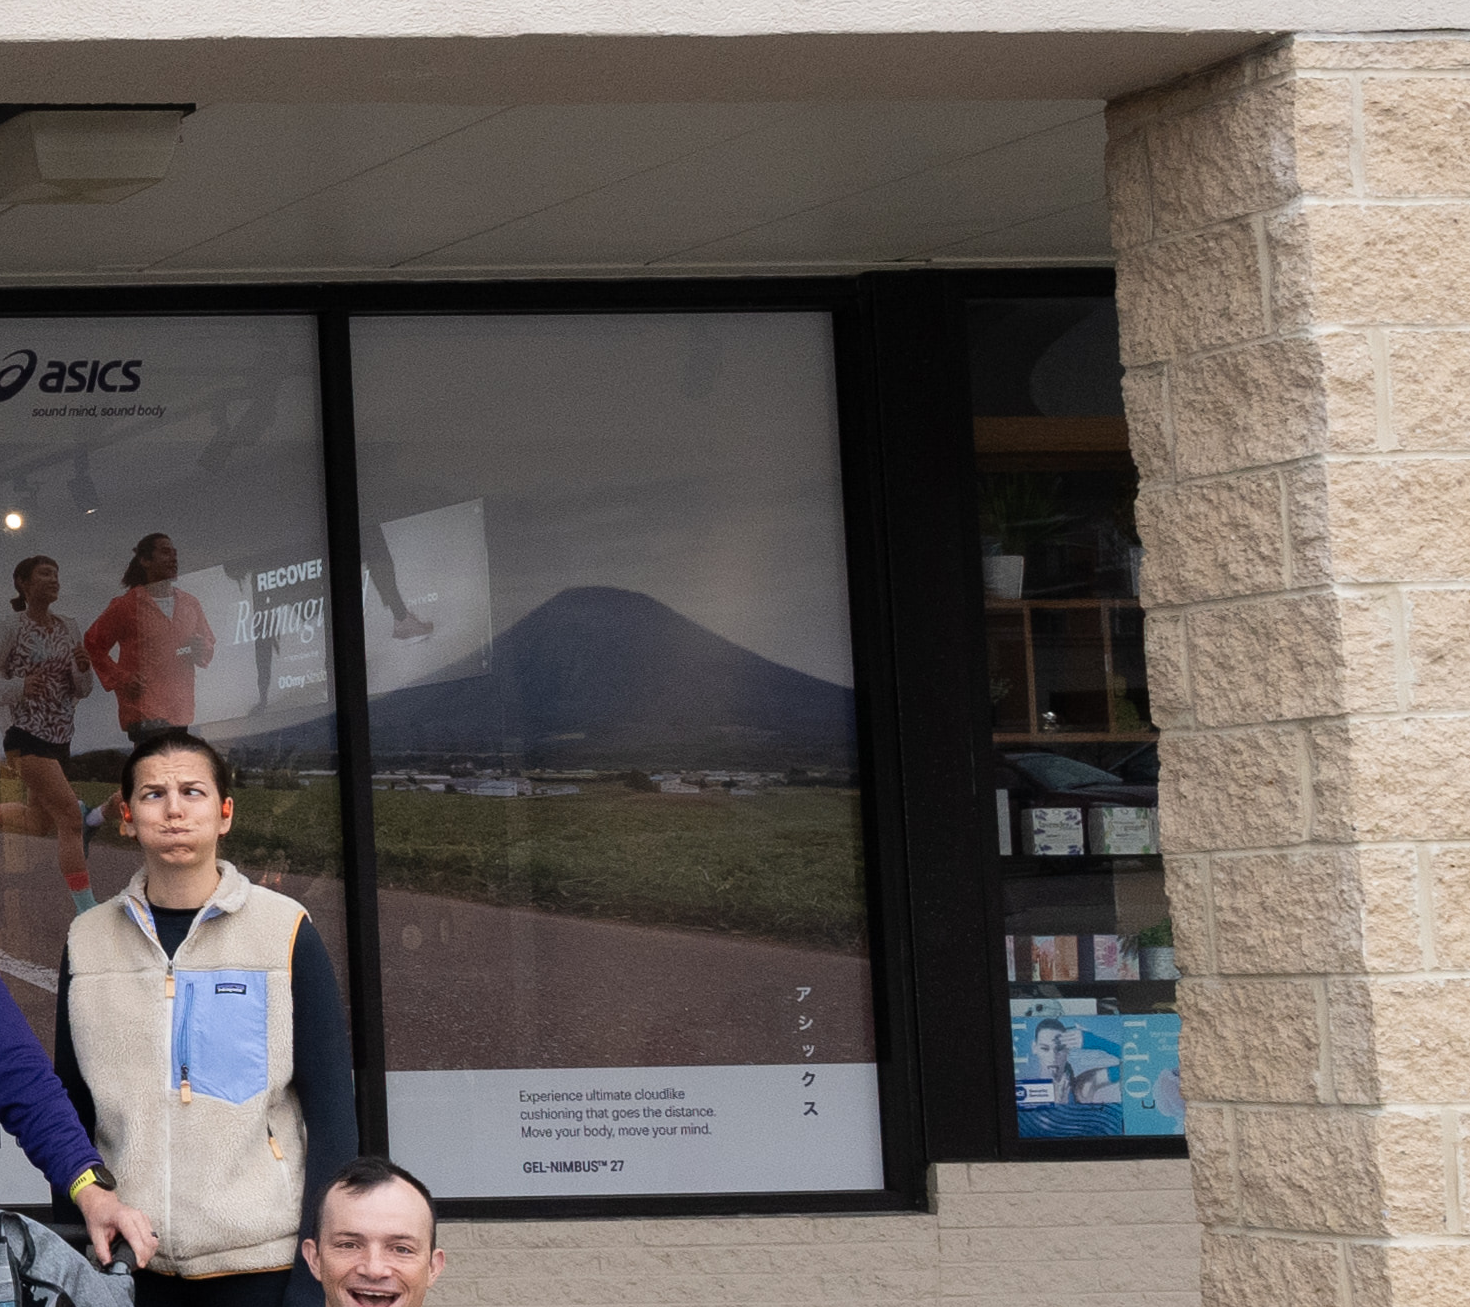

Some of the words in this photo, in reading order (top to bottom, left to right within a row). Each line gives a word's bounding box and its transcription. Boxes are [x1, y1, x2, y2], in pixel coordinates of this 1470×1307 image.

[32, 406, 67, 417] sound
[101, 406, 136, 416] sound
[138, 405, 166, 418] body
[519, 1090, 583, 1103] Experience
[585, 1089, 631, 1101] ultimate
[634, 1088, 685, 1100] cloudlike
[520, 1108, 583, 1122] cushioning
[585, 1107, 608, 1119] that
[612, 1109, 639, 1121] goes
[643, 1107, 662, 1118] the
[665, 1106, 716, 1118] distance.
[521, 1126, 552, 1138] Move
[555, 1127, 580, 1140] your
[584, 1125, 615, 1139] body,
[618, 1126, 649, 1136] move
[652, 1126, 677, 1139] your
[680, 1123, 711, 1135] mind.
[610, 1160, 624, 1172] 27
